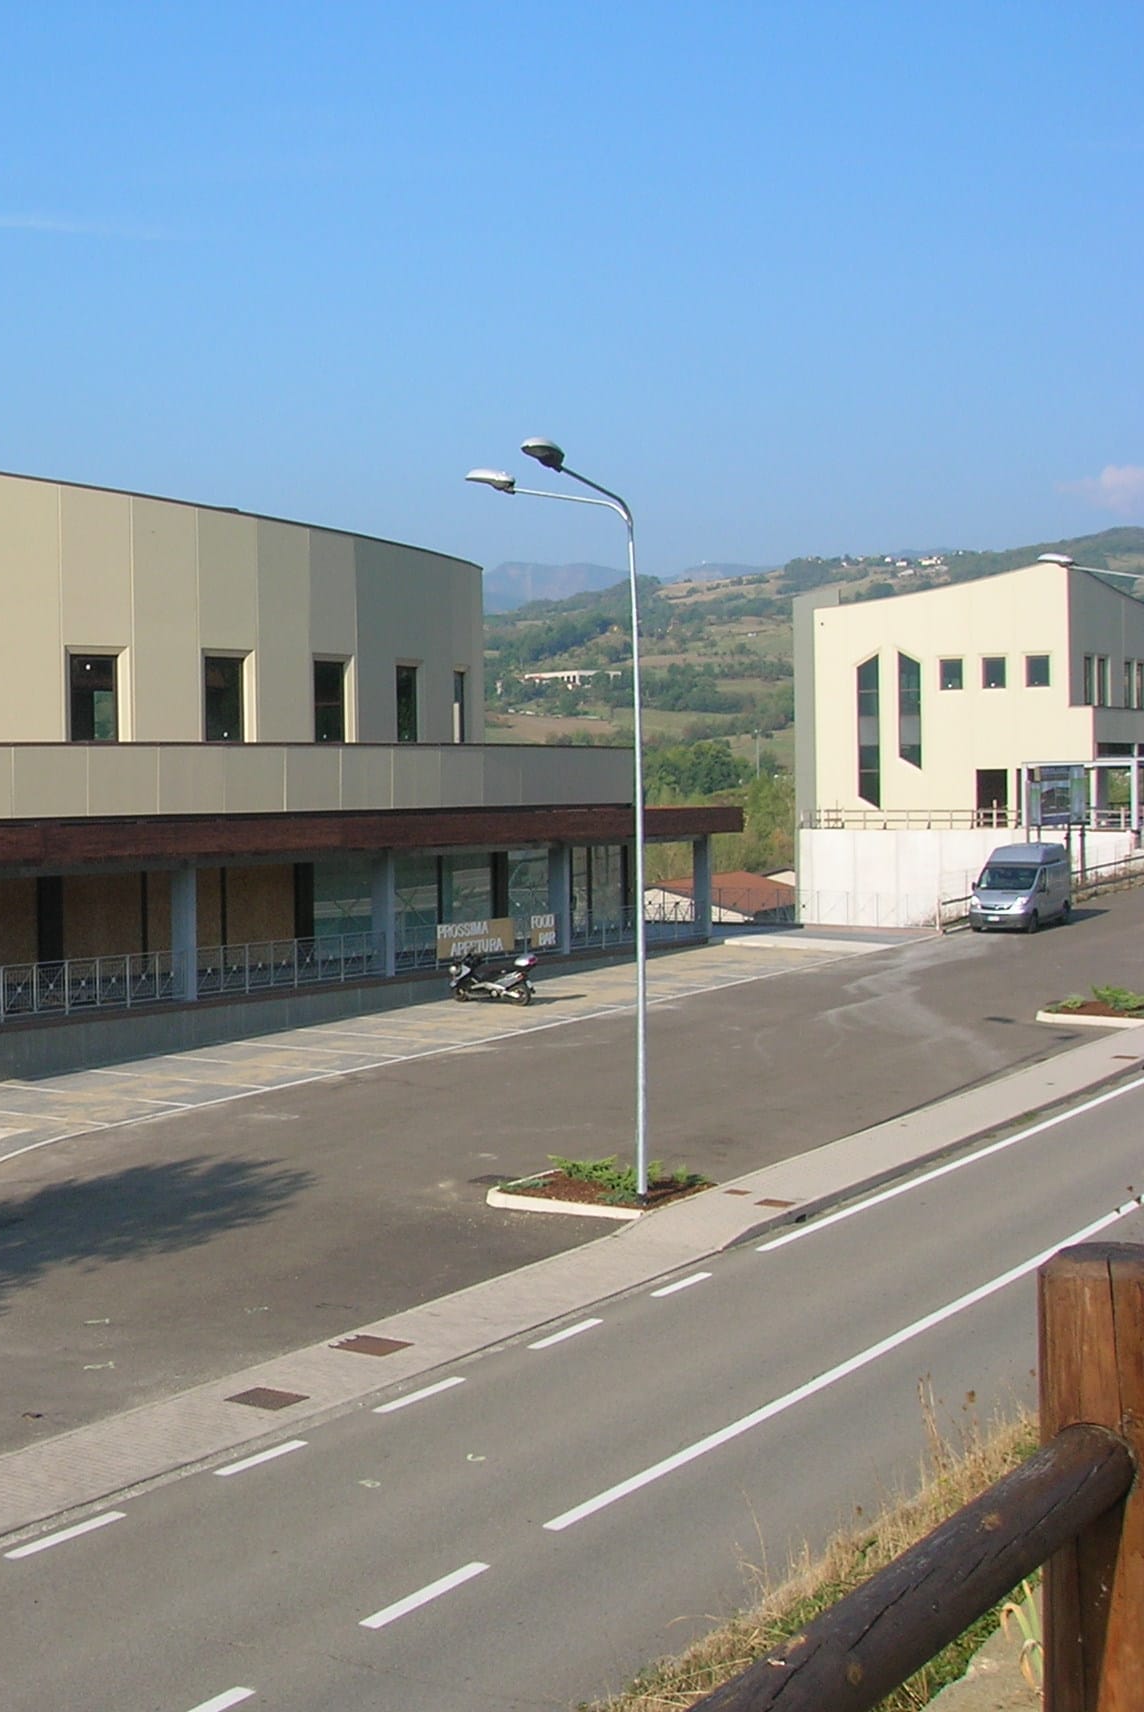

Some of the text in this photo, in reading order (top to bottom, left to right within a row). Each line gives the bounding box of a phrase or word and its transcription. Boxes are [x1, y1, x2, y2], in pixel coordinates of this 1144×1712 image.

[531, 913, 554, 929] FOOD
[437, 921, 489, 939] PROSSIMA
[538, 931, 556, 946] BAR
